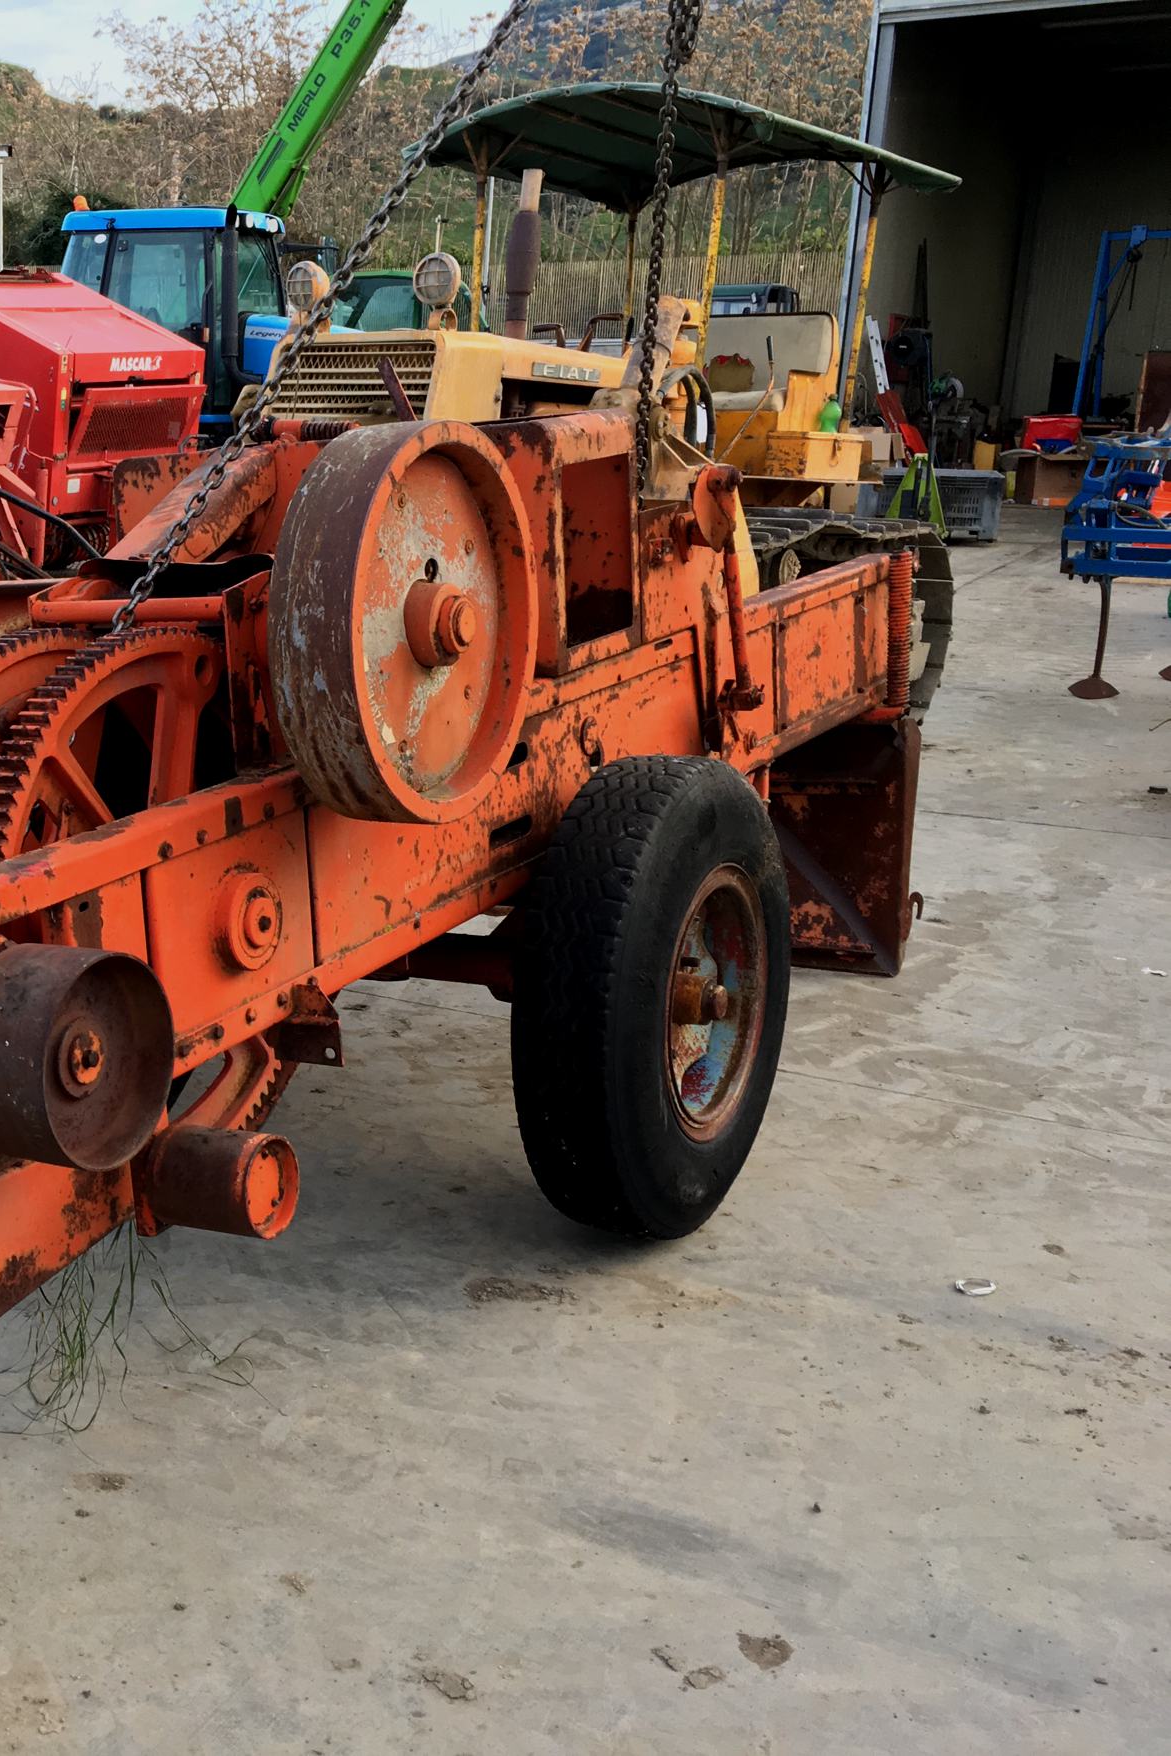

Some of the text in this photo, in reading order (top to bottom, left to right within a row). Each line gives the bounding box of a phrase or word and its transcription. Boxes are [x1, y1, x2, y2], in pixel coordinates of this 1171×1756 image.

[287, 73, 326, 132] MERLO
[109, 356, 153, 372] MASCAR
[543, 363, 594, 381] FIAT
